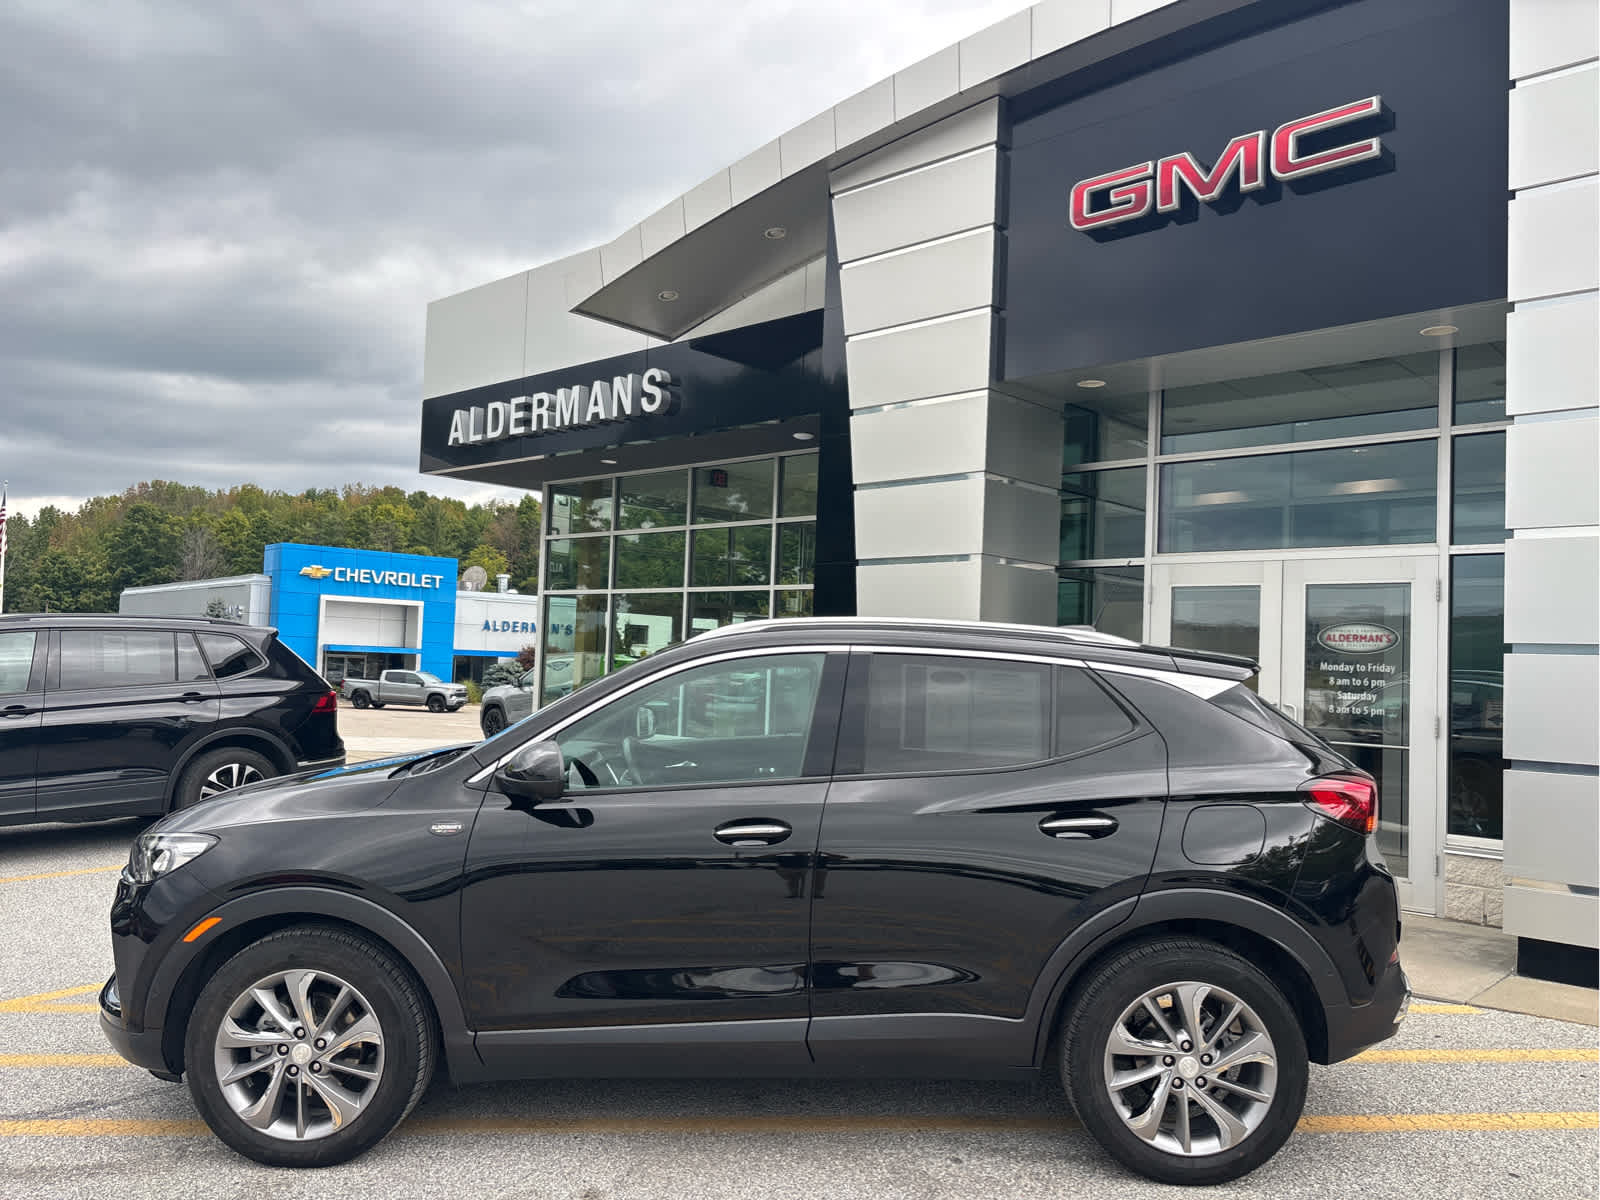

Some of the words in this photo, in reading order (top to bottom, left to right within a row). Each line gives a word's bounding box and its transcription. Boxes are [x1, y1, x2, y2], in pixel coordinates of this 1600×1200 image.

[1069, 95, 1381, 231] GMC
[448, 367, 669, 446] ALDERMANS
[334, 567, 444, 589] CHEVROLET
[481, 619, 573, 636] ALDERMN'S
[1325, 633, 1393, 644] ALDERMAN'S
[1319, 662, 1354, 673] Monday
[1356, 663, 1365, 672] to
[1367, 663, 1395, 674] Friday
[1329, 677, 1335, 686] 8
[1336, 678, 1350, 686] am
[1352, 677, 1361, 686] to
[1363, 677, 1369, 686] 6
[1371, 679, 1386, 688] pm
[1337, 691, 1377, 702] Saturday
[1328, 705, 1335, 714] 8
[1336, 706, 1349, 714] am
[1352, 706, 1361, 715] to
[1363, 706, 1369, 715] 5
[1370, 708, 1385, 717] pm
